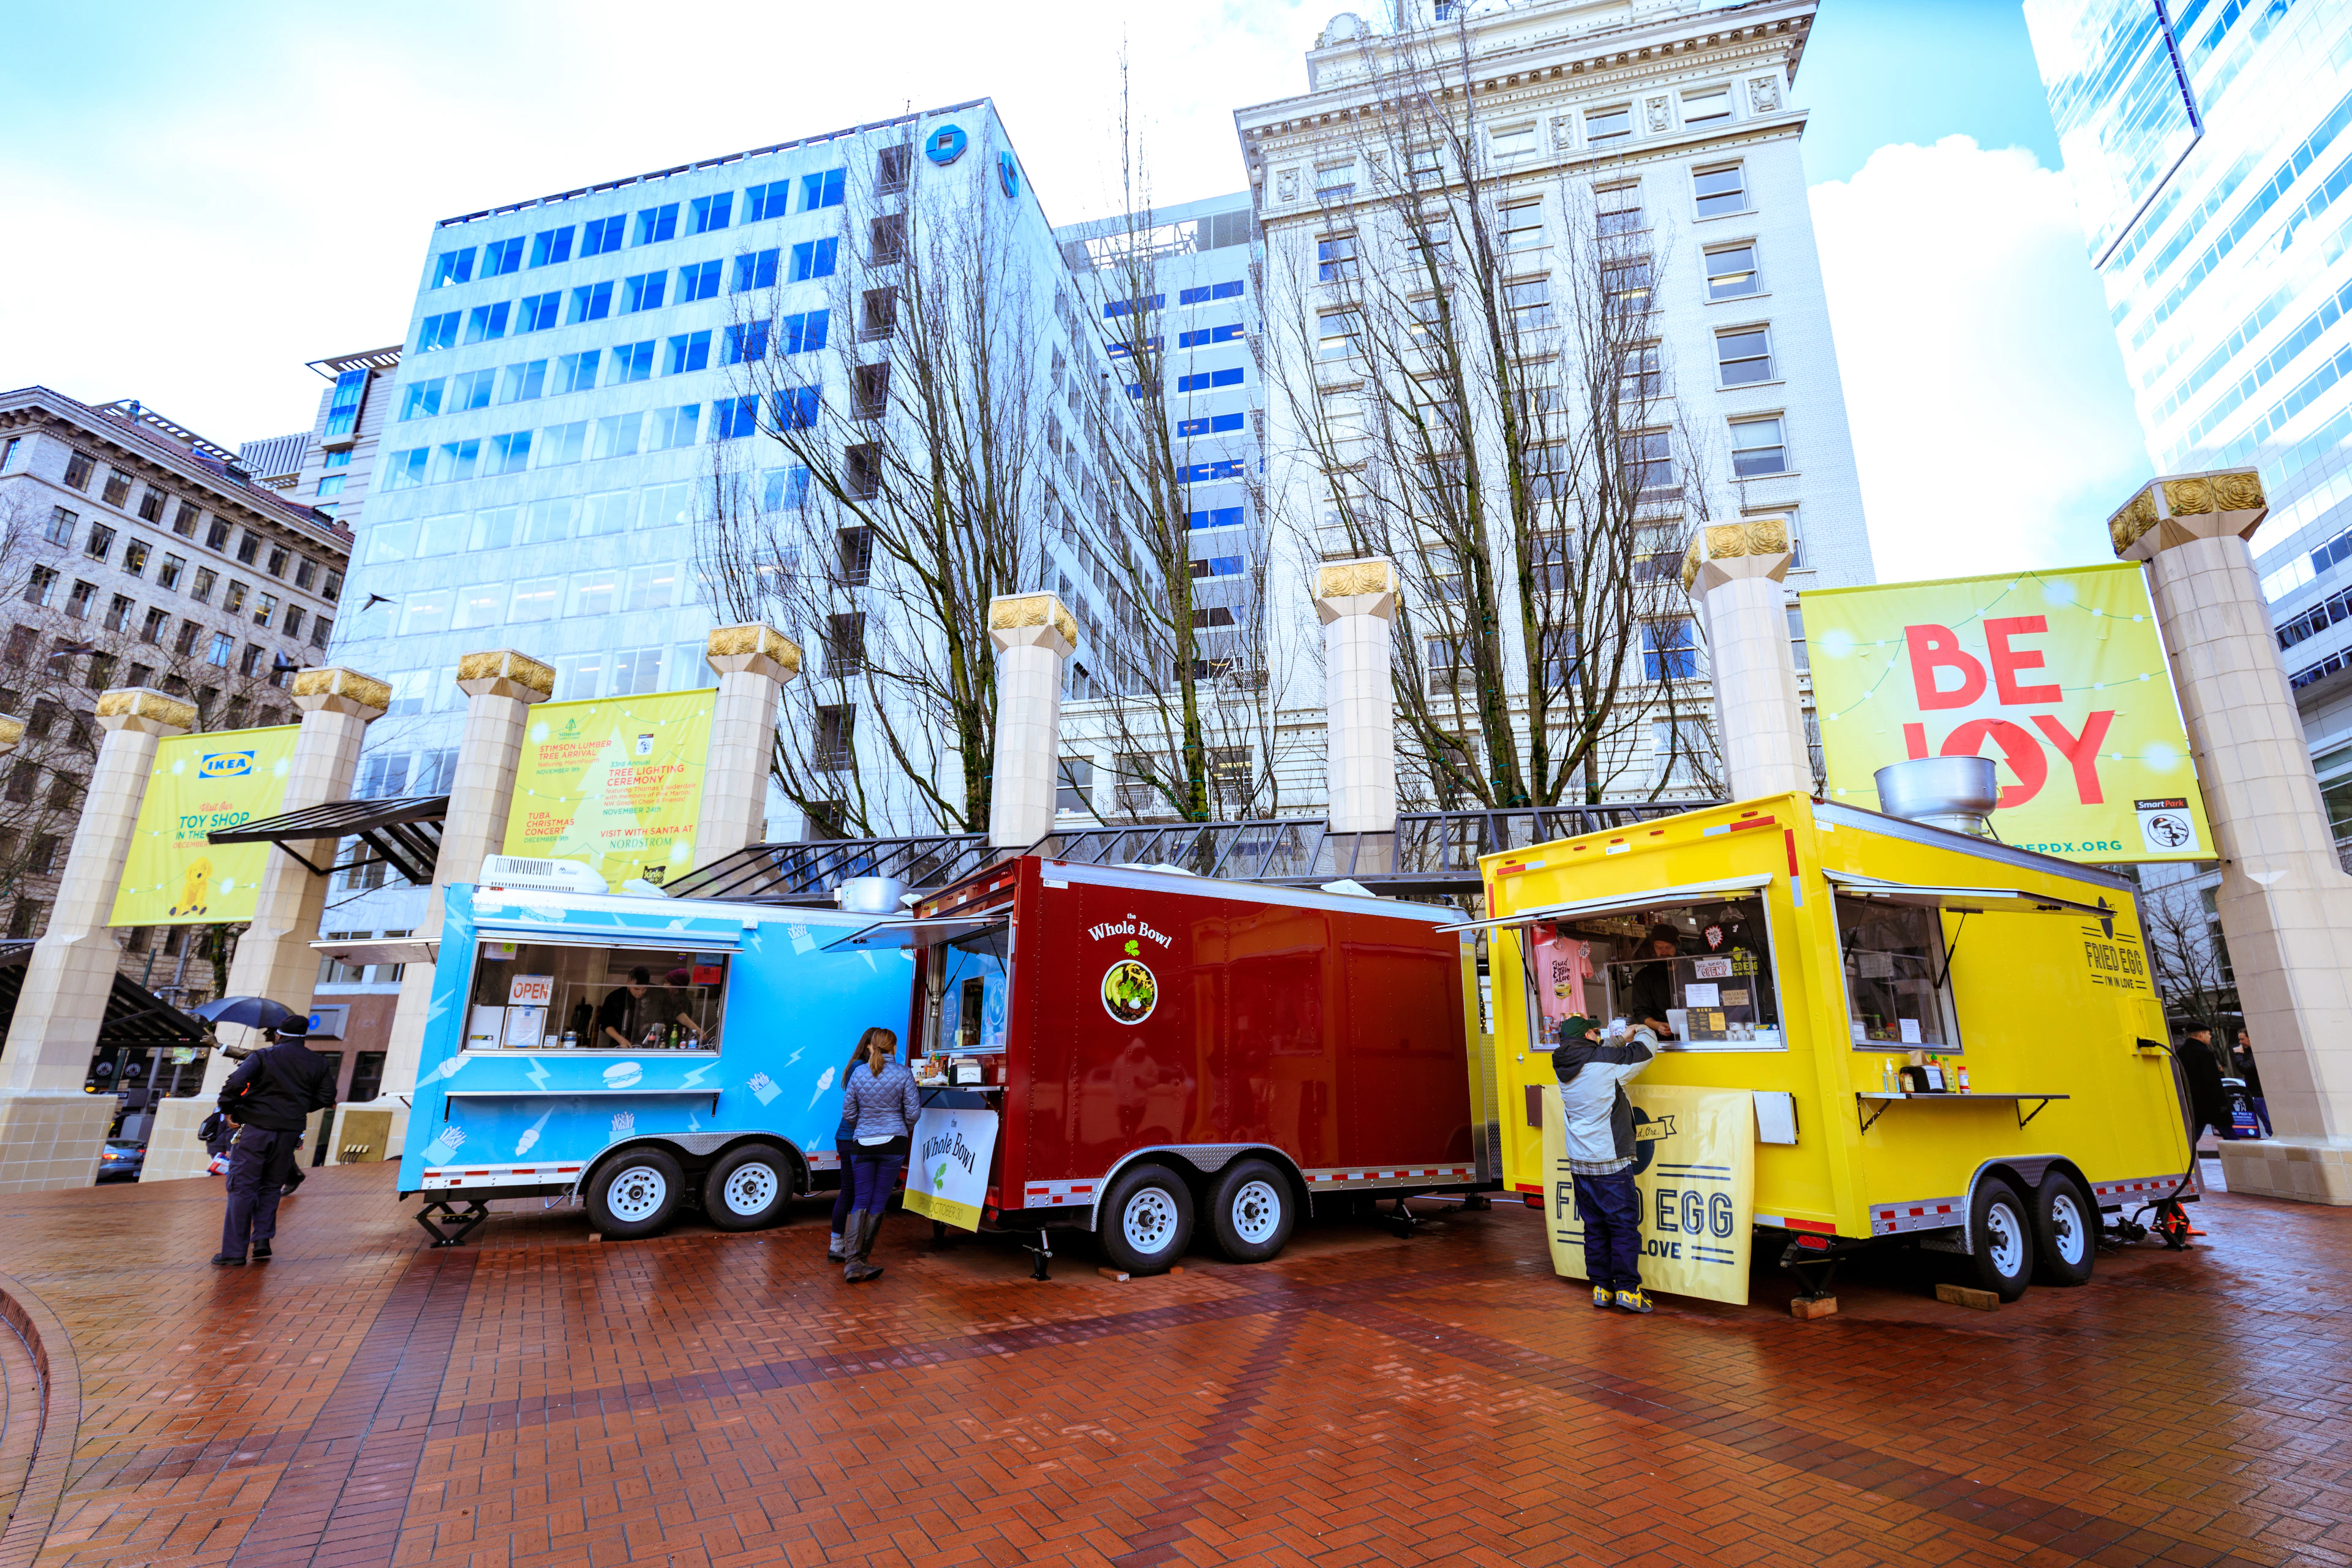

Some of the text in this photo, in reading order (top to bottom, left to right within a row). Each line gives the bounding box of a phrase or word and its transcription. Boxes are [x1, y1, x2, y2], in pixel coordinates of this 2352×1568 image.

[1905, 614, 2064, 710] BE
[540, 740, 612, 753] STIMSON LUMBER
[561, 749, 596, 758] ARRIVAL
[207, 758, 246, 771] IKEA
[609, 764, 684, 777] TREE LIGHTING
[607, 775, 664, 786] CEREMONY
[199, 801, 233, 812] Visit Our
[2138, 799, 2184, 809] SmartPark
[603, 807, 644, 816] NOVEMBER
[179, 812, 249, 828] TOY SHOP
[526, 818, 575, 827] CHRISTMAS
[175, 831, 186, 840] IN
[188, 829, 206, 839] THE
[525, 827, 565, 835] CONCERT
[650, 826, 679, 835] SANTA
[173, 840, 209, 849] DECEMBER
[609, 837, 672, 848] NORDSTROM
[1088, 921, 1172, 949] Whole Bowl
[1552, 957, 1569, 970] Fried
[2084, 941, 2144, 975] FRIED EGG
[1702, 966, 1727, 977] OPEN!
[2105, 976, 2135, 989] I'M IN LOVE
[513, 982, 549, 999] OPEN
[1645, 1127, 1660, 1136] Ore.
[922, 1133, 976, 1175] Whole Bowl
[929, 1202, 956, 1218] OCTOBER
[956, 1208, 963, 1220] 30
[1656, 1189, 1733, 1238] EGG
[1638, 1238, 1681, 1259] LOVE
